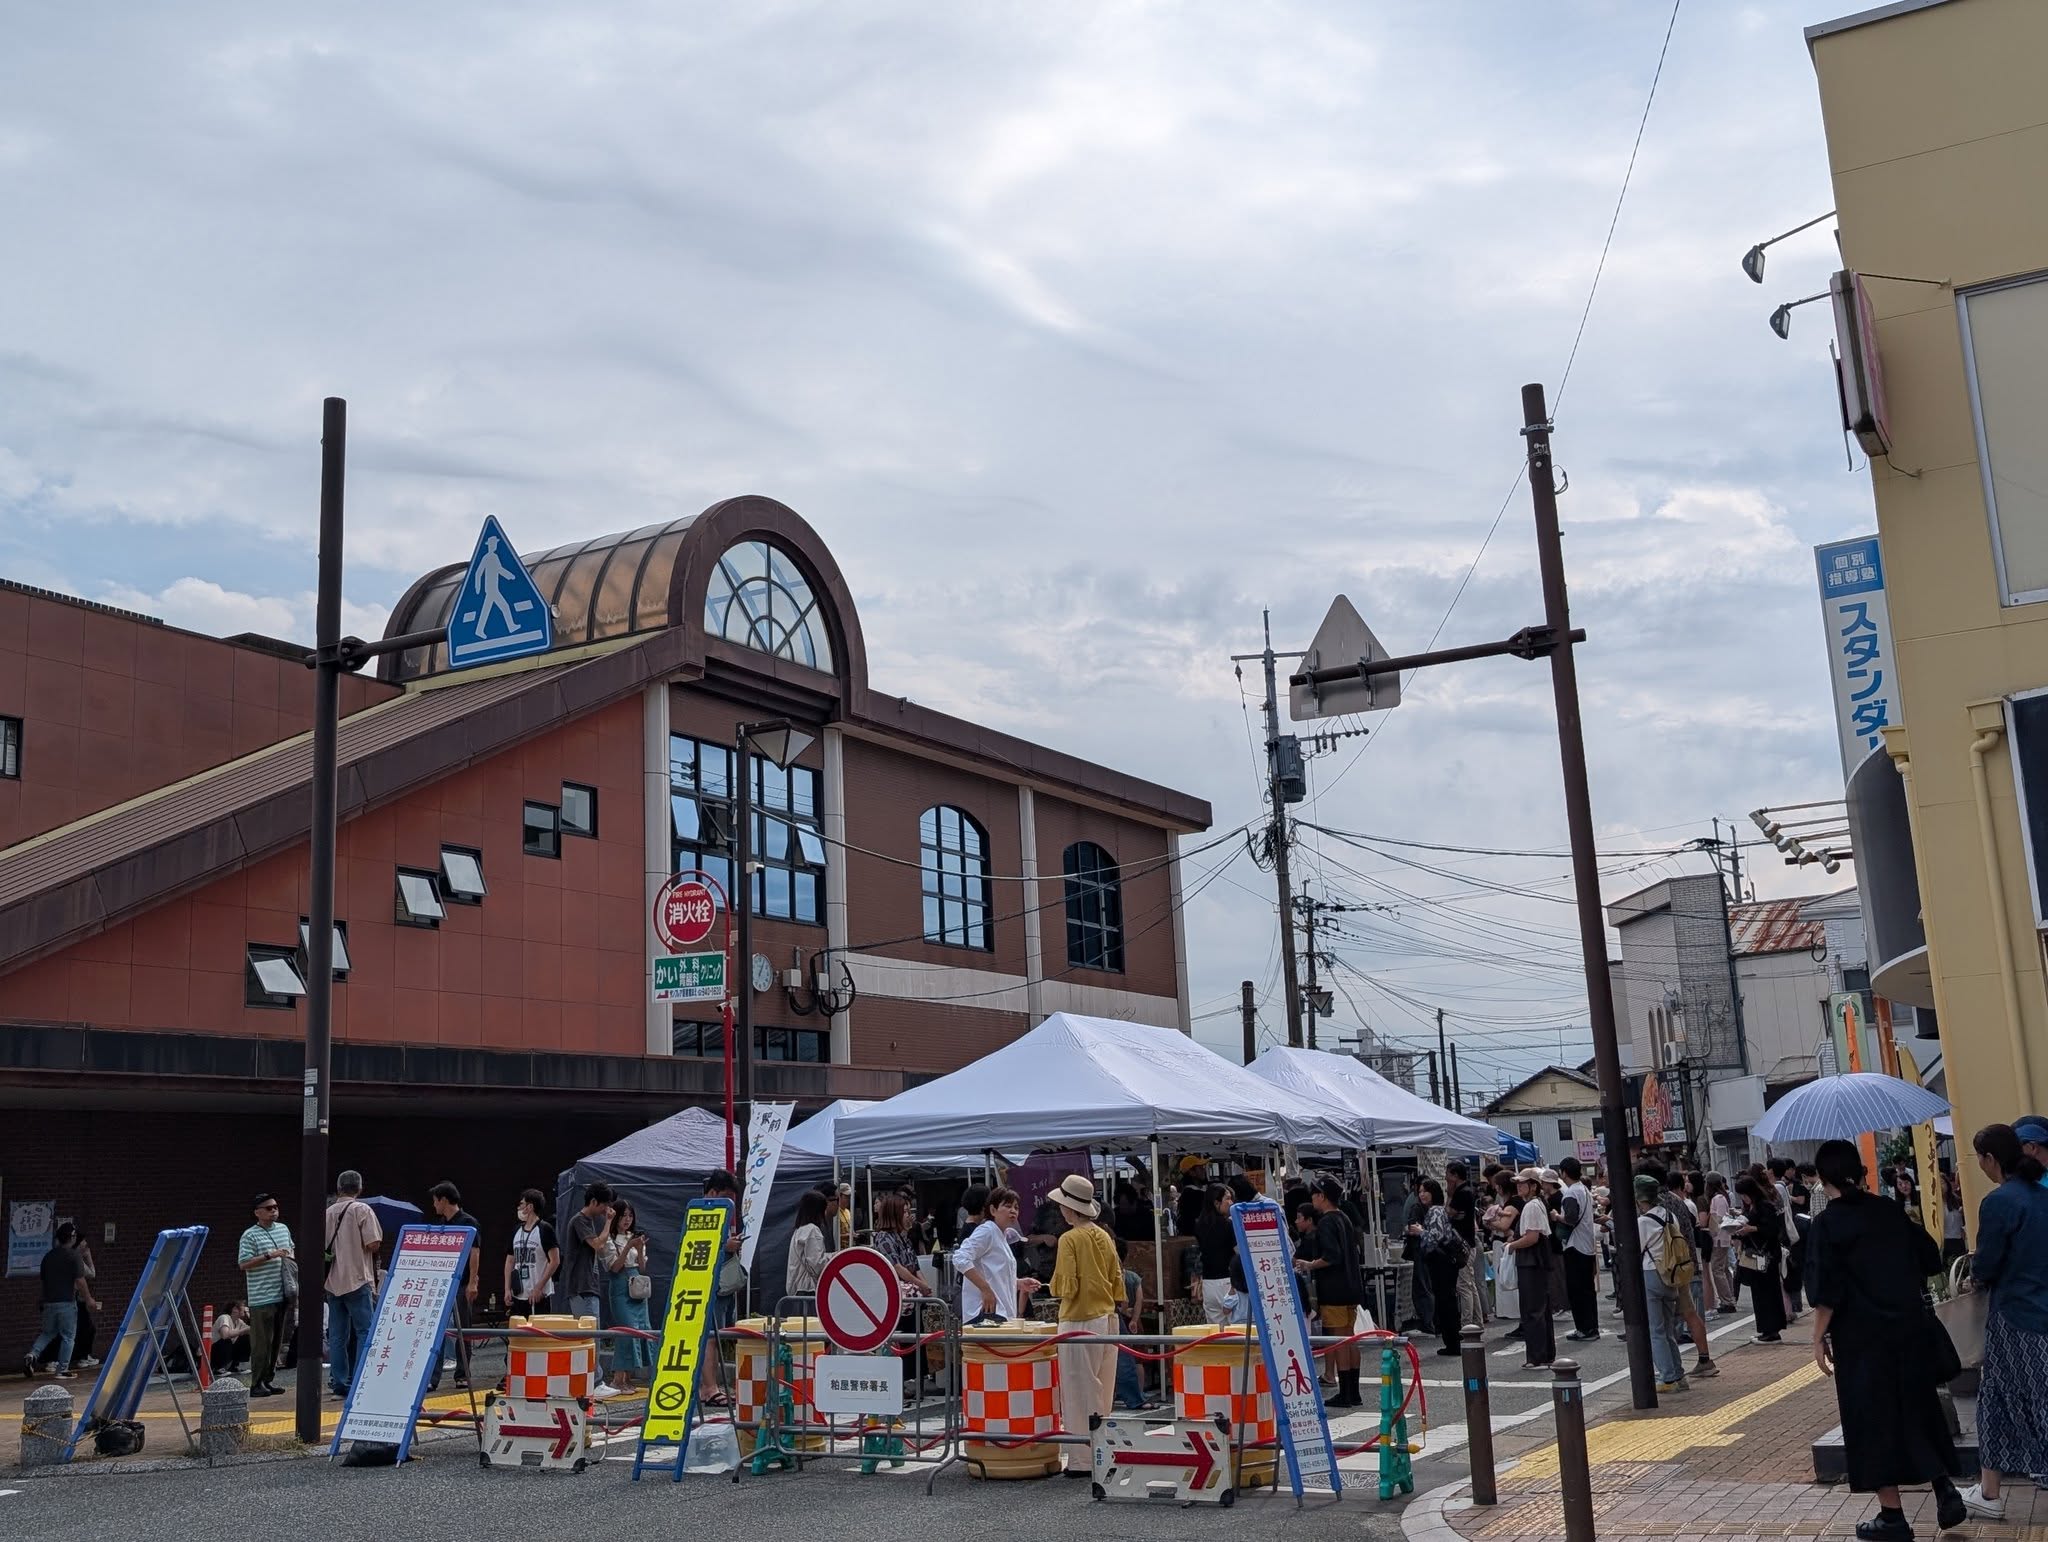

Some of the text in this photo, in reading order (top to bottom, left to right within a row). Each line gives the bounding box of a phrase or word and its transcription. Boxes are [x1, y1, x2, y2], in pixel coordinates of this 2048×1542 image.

[1834, 552, 1866, 570] 個別
[1828, 566, 1876, 586] 指導塾
[672, 889, 706, 899] FIRE HYDRANT
[669, 899, 711, 925] 消火栓
[680, 957, 699, 972] 外科
[700, 962, 722, 980] クリニック
[656, 965, 678, 985] かい
[403, 1233, 465, 1246] 交通社会実験中
[404, 1277, 428, 1325] 迂回を
[425, 1278, 449, 1340] 実験期間中は
[662, 1240, 712, 1371] 通行止
[1259, 1257, 1285, 1345] おしチャリ
[376, 1277, 414, 1377] お願いします
[830, 1379, 889, 1393] 粕屋警察署長
